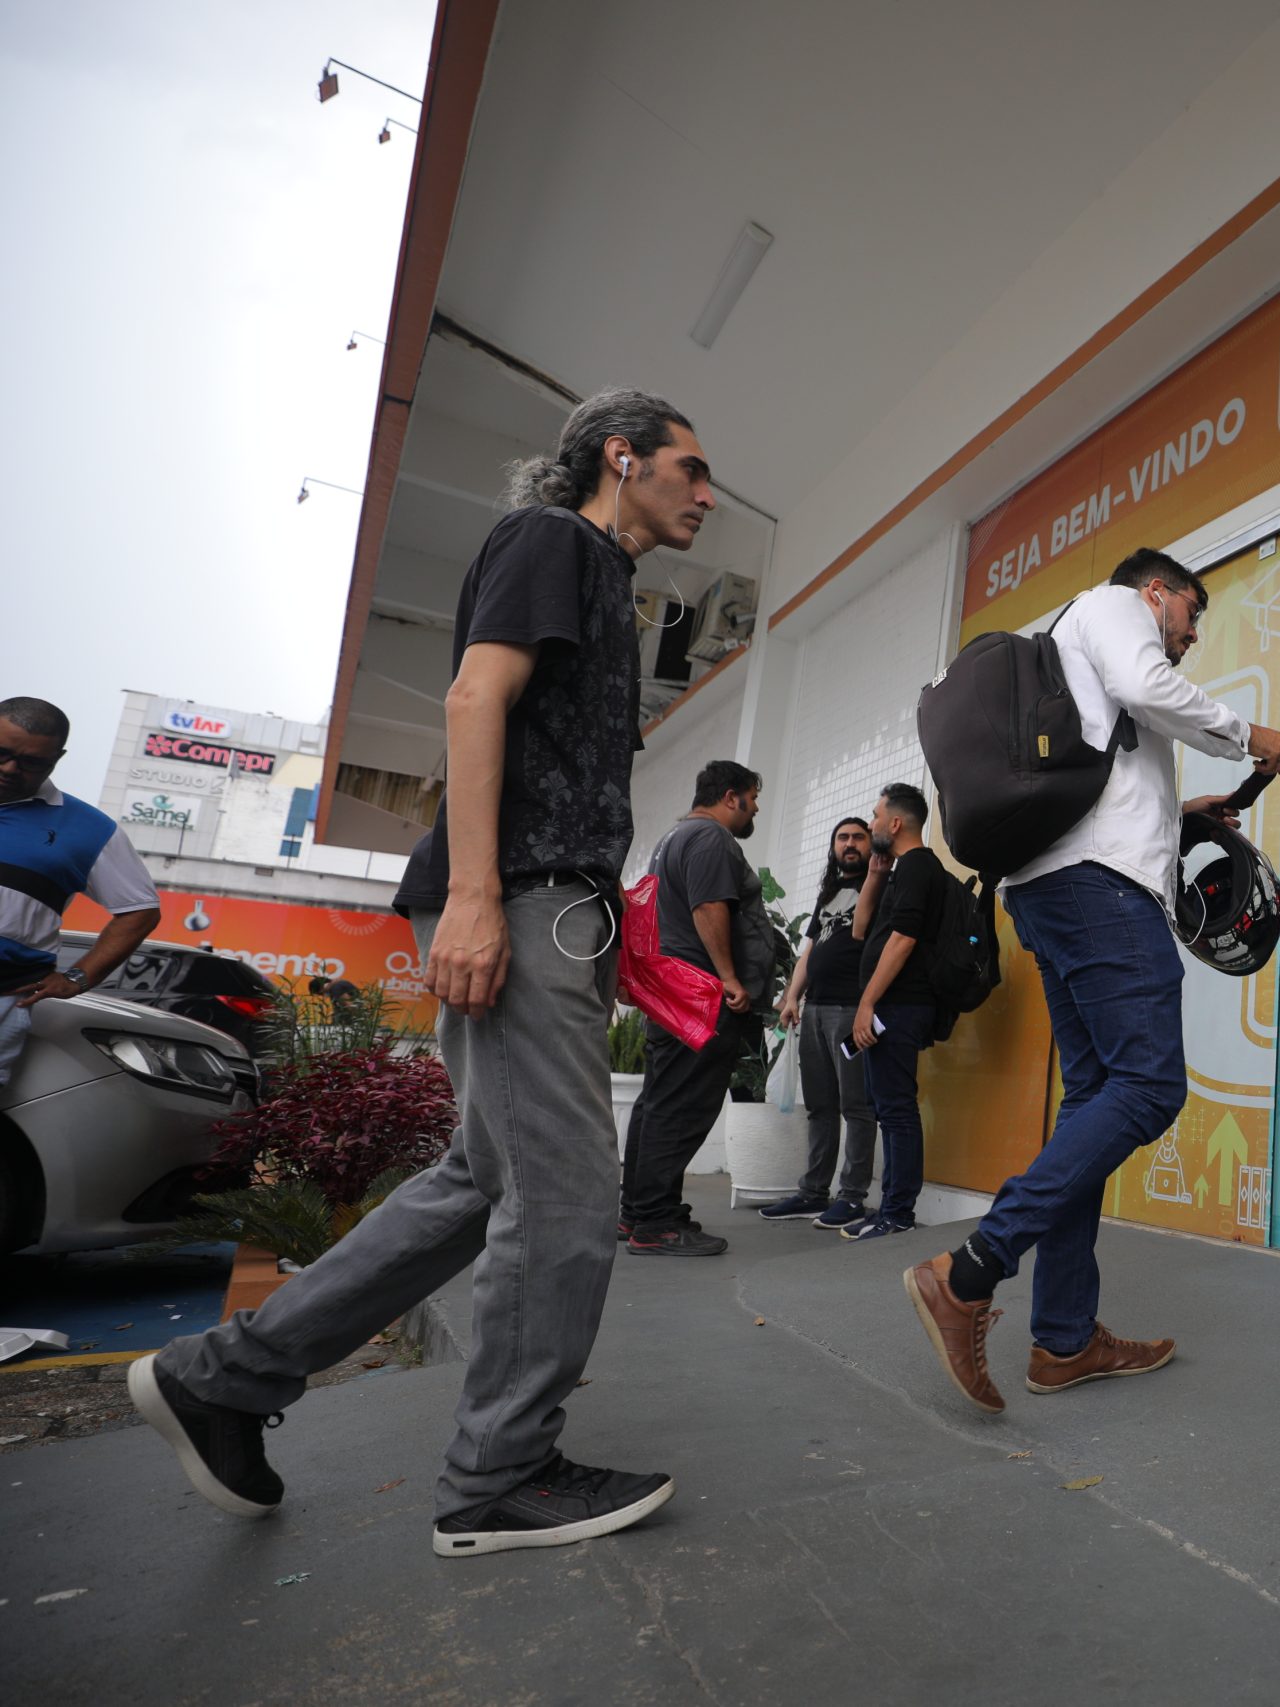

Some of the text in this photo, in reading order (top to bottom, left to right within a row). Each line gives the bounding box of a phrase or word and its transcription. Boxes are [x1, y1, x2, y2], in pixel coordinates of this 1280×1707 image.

[986, 398, 1246, 597] SEJA BEM-VINDO
[130, 768, 208, 789] STUDIO
[131, 802, 192, 823] Samel
